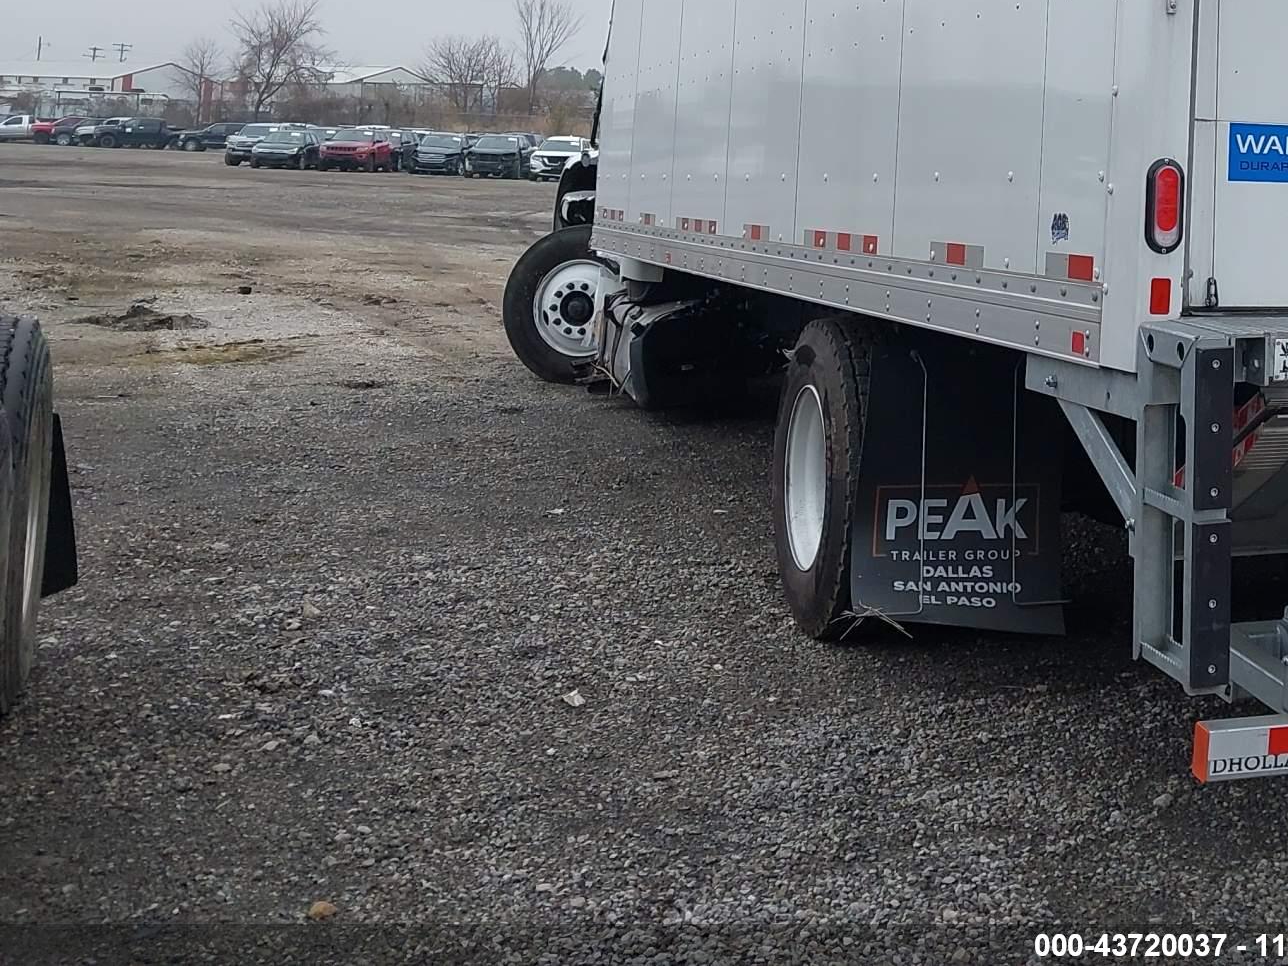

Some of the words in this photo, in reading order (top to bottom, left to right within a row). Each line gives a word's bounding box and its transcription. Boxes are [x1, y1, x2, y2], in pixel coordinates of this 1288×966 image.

[885, 492, 1029, 540] PEAK
[890, 550, 958, 561] TRAILER
[922, 565, 993, 578] DALLAS
[893, 580, 932, 592] SAN
[936, 581, 1022, 594] ANTONIO
[919, 595, 941, 605] EL
[946, 596, 997, 607] PASO
